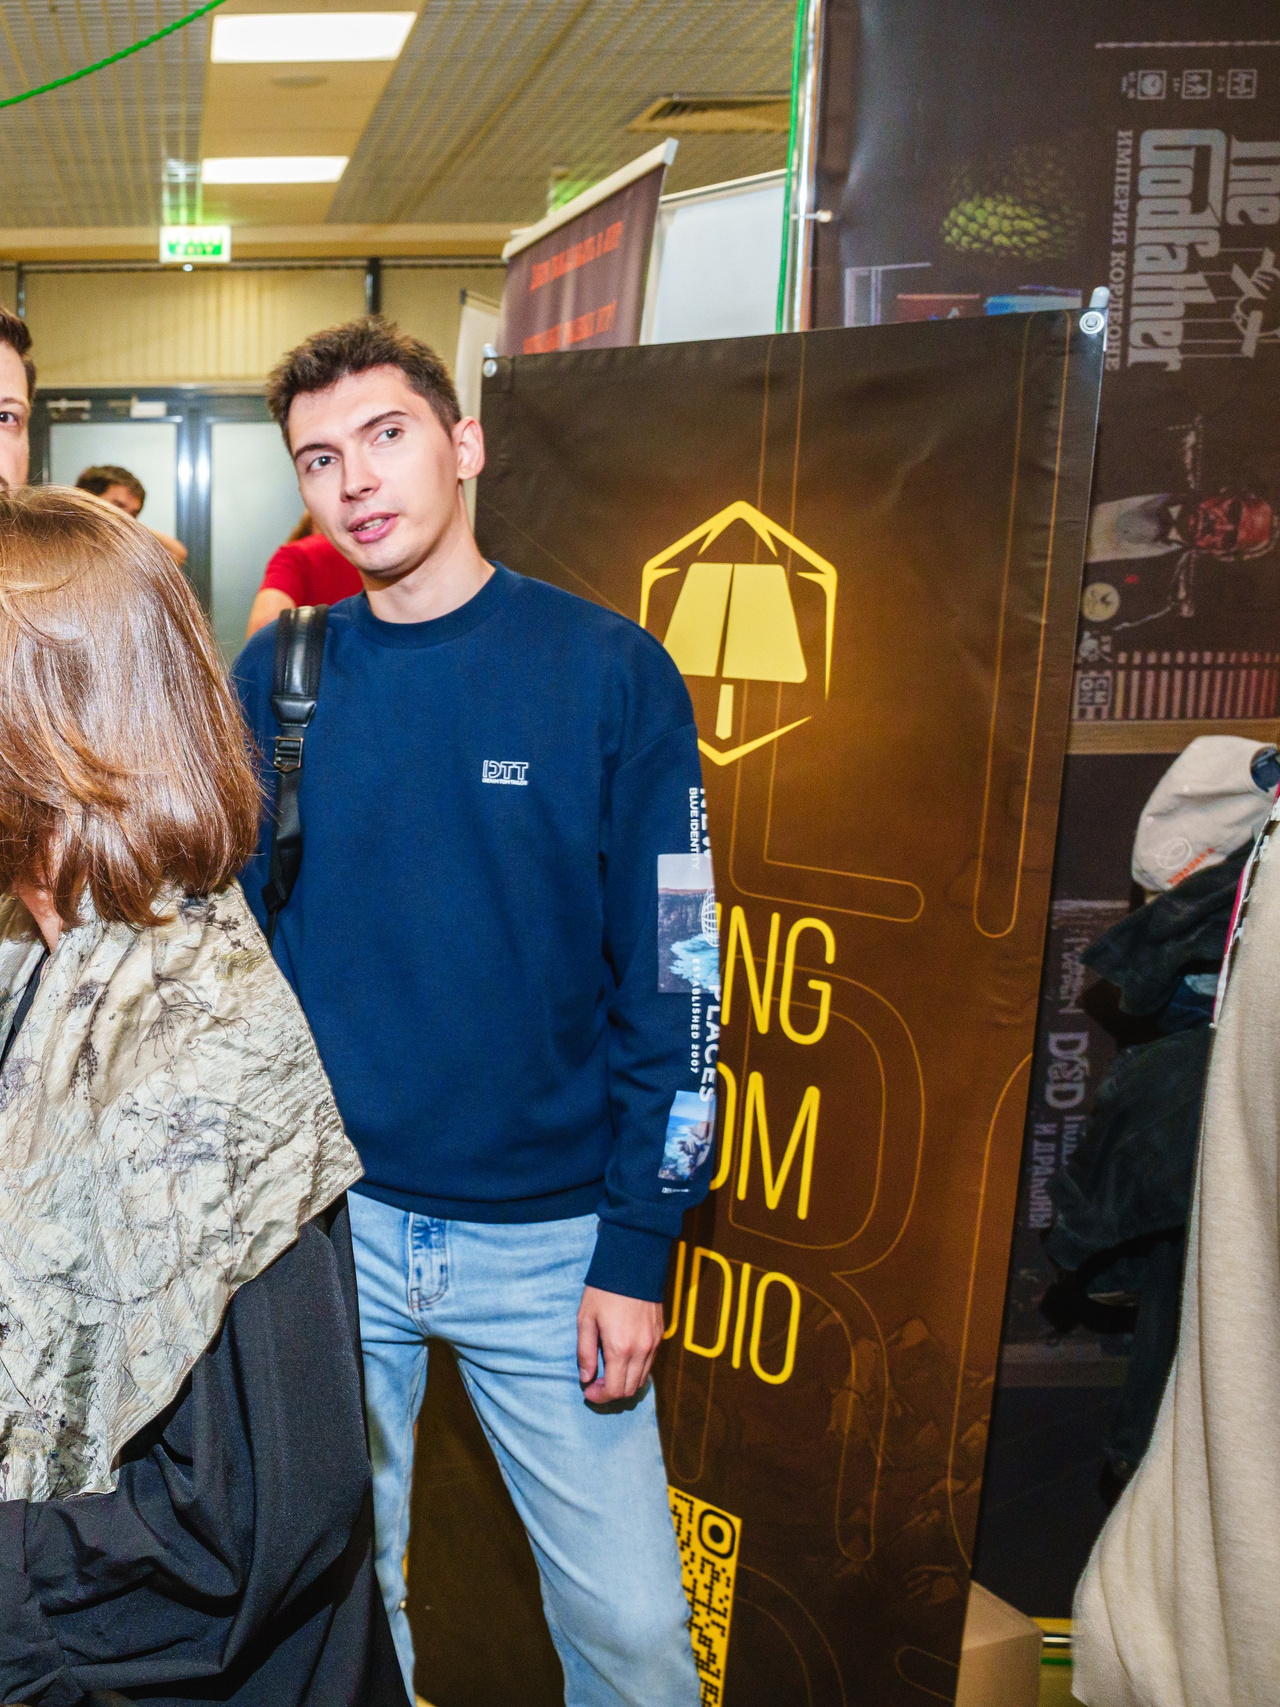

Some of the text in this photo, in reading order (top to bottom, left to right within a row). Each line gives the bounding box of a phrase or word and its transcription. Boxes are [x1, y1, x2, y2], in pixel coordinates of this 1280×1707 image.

[1104, 130, 1133, 371] ИМПЕРИЯ КОРЛЕОНЕ
[1127, 129, 1227, 371] Godfather
[688, 787, 701, 871] BLUE IDENTITY
[689, 958, 701, 1074] ESTABLISHED 2007
[715, 902, 836, 1046] NG
[699, 984, 721, 1103] PLACES
